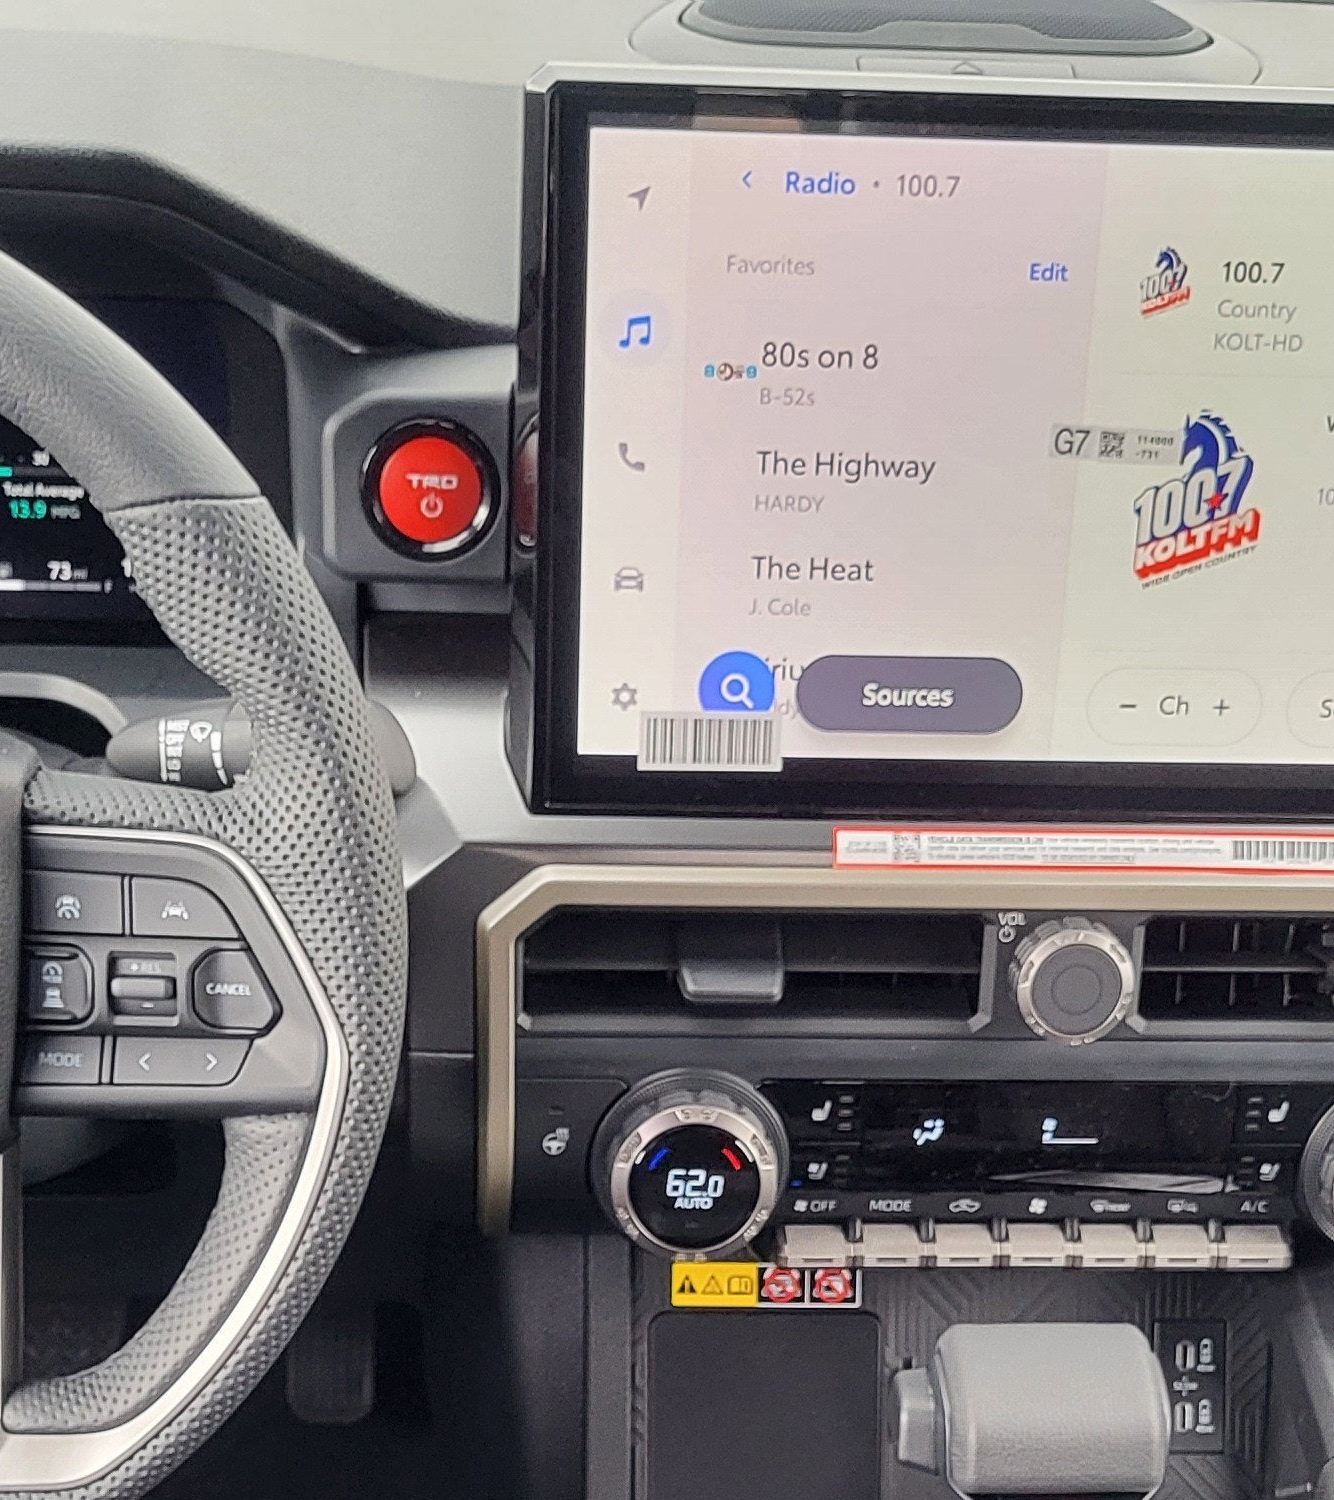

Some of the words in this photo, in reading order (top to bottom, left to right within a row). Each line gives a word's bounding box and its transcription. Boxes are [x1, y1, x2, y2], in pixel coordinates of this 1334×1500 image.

[785, 171, 857, 196] Radio
[896, 174, 961, 199] 100.7
[726, 254, 816, 277] Favorites
[1028, 261, 1069, 284] Edit
[1222, 261, 1286, 284] 100.7
[1218, 299, 1298, 324] Country
[1213, 332, 1304, 352] KOLT-HD
[761, 342, 810, 368] 80s
[818, 350, 854, 370] on
[862, 344, 879, 371] 8
[759, 387, 816, 407] B-52s
[1053, 428, 1091, 456] G7
[756, 450, 807, 477] The
[813, 452, 937, 485] Highway
[405, 473, 459, 490] TRD
[8, 499, 48, 519] 13.9
[754, 494, 825, 513] HARDY
[47, 560, 72, 581] 73
[752, 556, 801, 582] The
[808, 557, 875, 583] Heat
[748, 598, 763, 617] J.
[766, 597, 812, 618] Cole
[861, 682, 956, 709] Sources
[1158, 694, 1190, 719] Ch
[998, 911, 1027, 926] VOL
[205, 981, 252, 996] CANCEL
[38, 1052, 83, 1068] MODE
[667, 1168, 725, 1200] 62.0
[673, 1198, 714, 1211] AUTO
[809, 1200, 837, 1212] OFF
[869, 1199, 913, 1212] MODE
[1239, 1200, 1269, 1213] A/C
